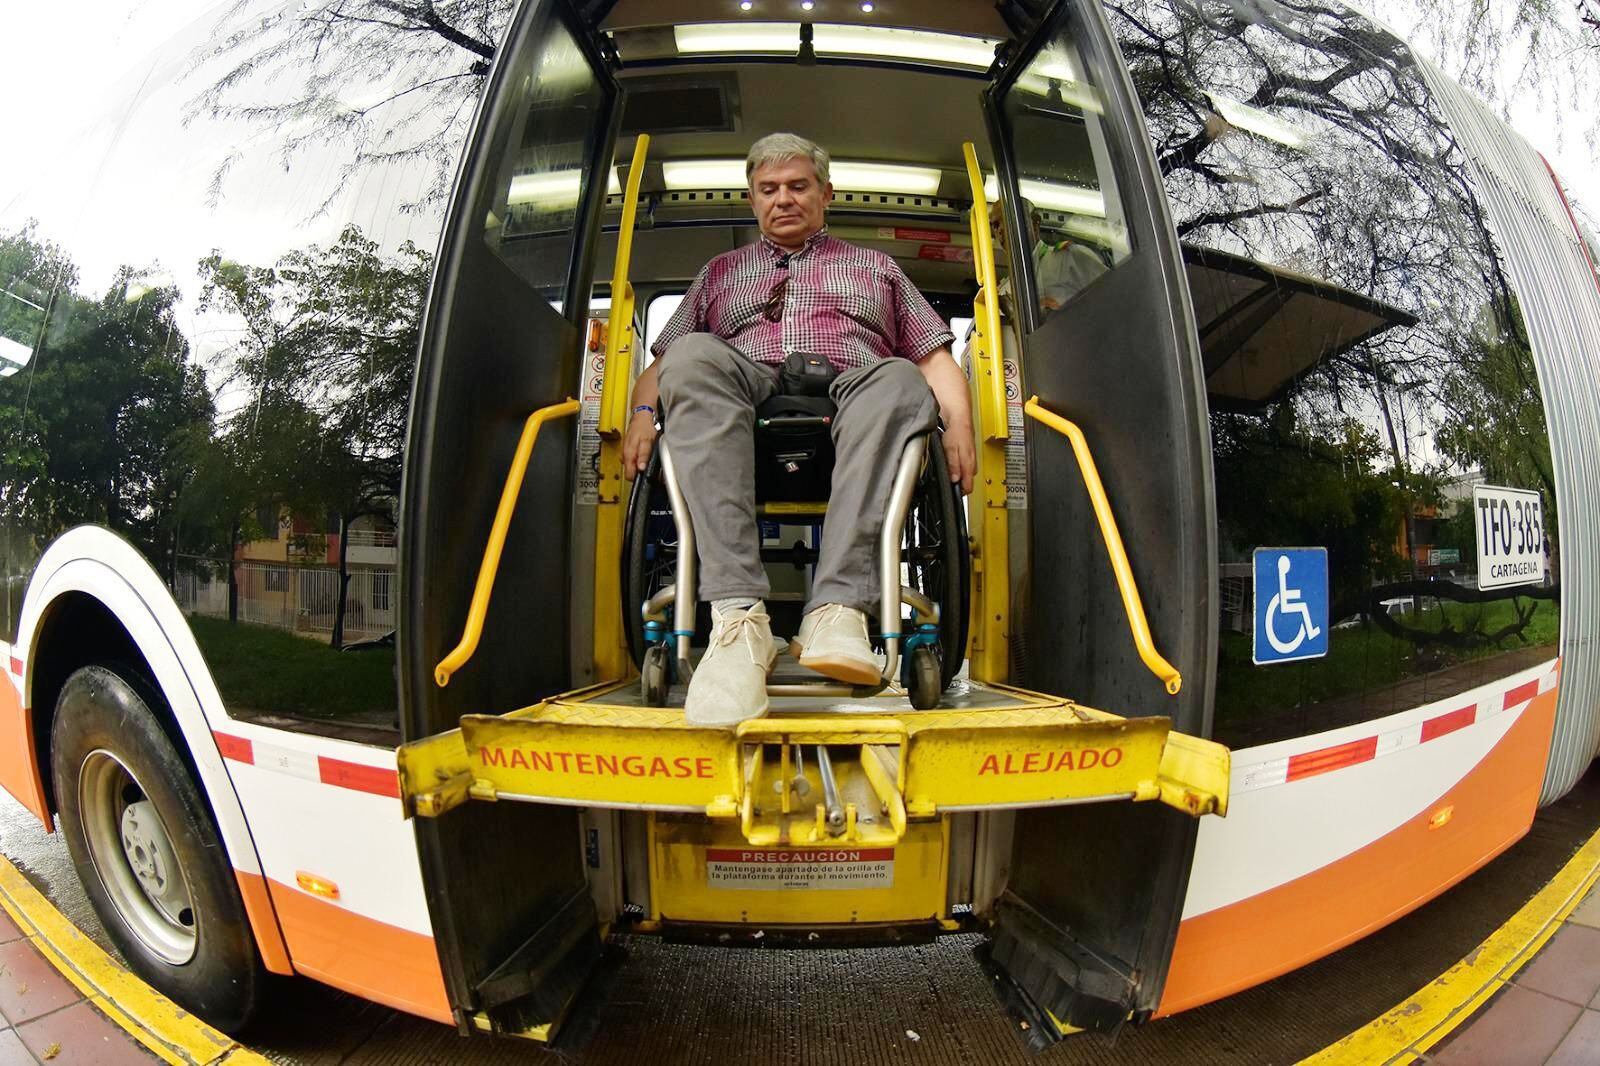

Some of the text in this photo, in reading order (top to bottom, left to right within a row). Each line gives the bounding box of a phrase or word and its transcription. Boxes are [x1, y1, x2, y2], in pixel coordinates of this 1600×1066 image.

[1490, 562, 1538, 578] CARTAGENA
[479, 745, 715, 779] MANTENGASE
[977, 747, 1123, 776] ALEJADO
[741, 850, 860, 862] PRECAUCIÓN
[714, 864, 773, 873] Mantengase
[775, 865, 819, 873] apartado
[847, 864, 872, 872] orilla
[723, 872, 776, 880] plataforma
[778, 872, 815, 880] durante
[818, 872, 827, 880] el
